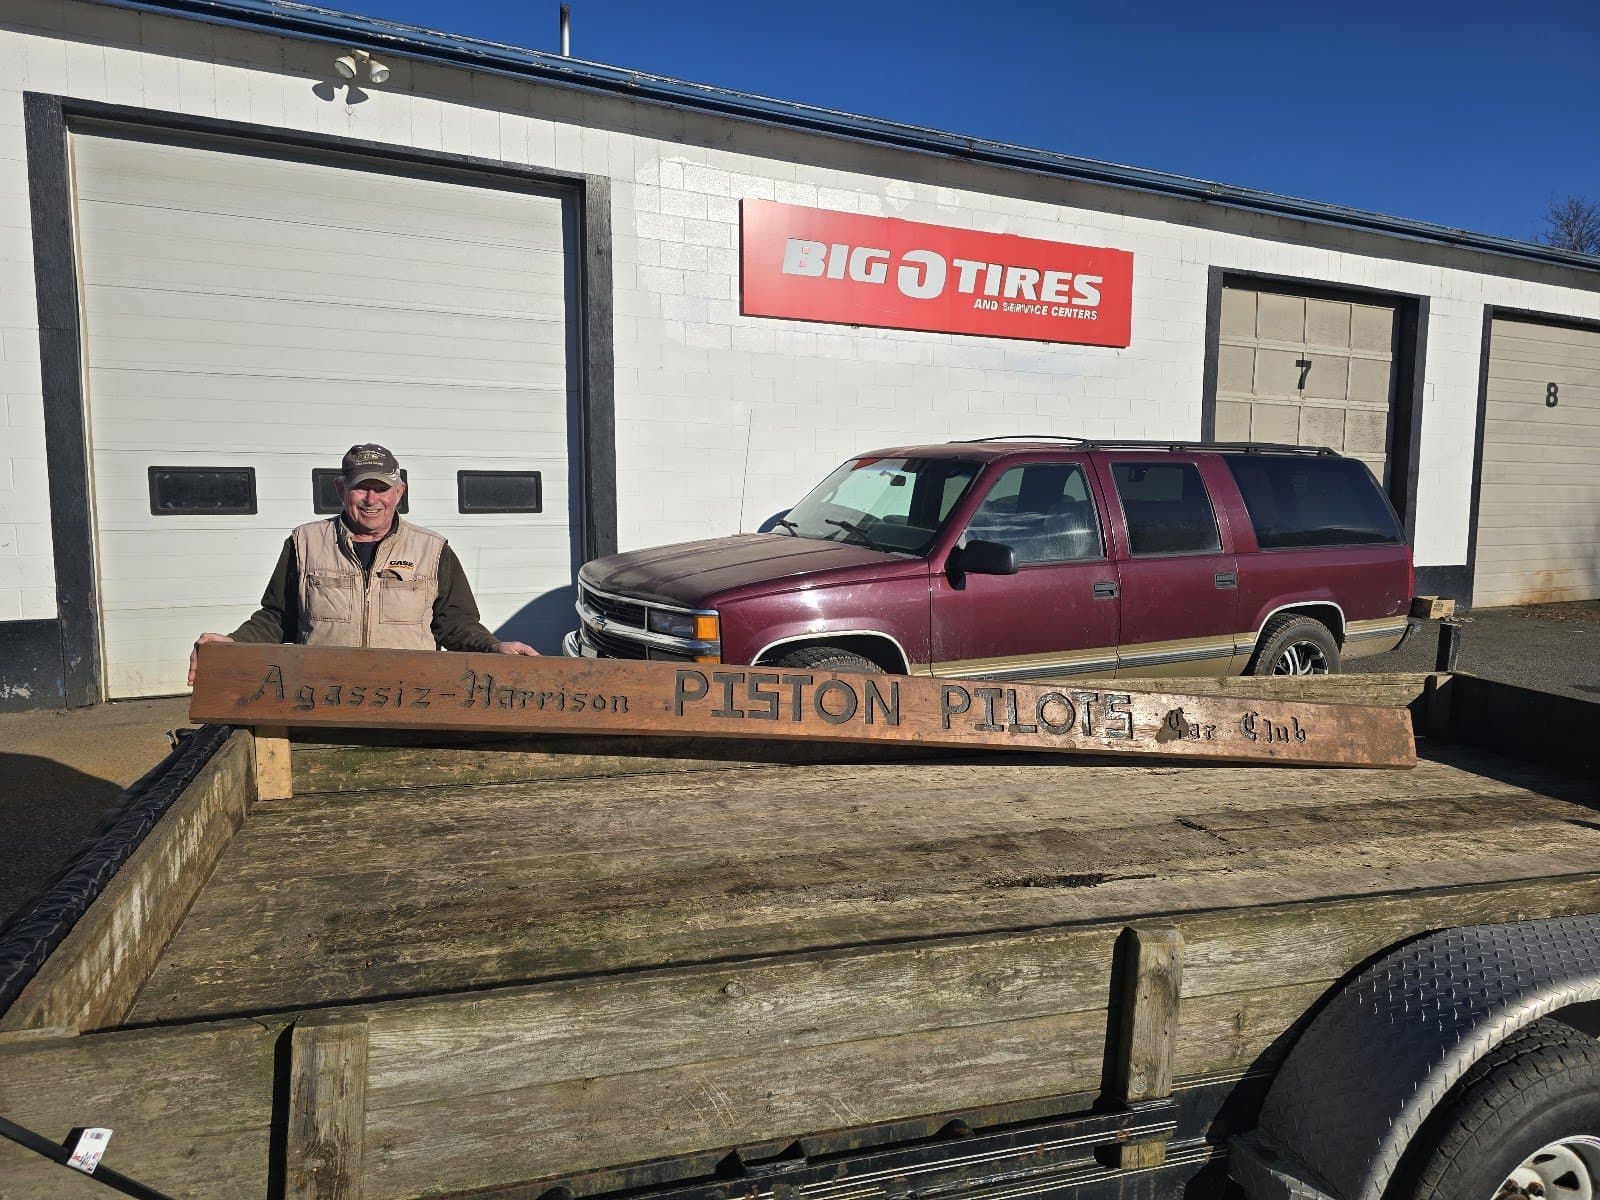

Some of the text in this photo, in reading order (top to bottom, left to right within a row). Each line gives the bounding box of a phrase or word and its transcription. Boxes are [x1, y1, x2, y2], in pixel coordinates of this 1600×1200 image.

[782, 237, 1104, 307] BIG O TIRES
[973, 298, 1098, 320] AND SERVICE CENTERS
[1295, 359, 1312, 389] 7
[1545, 382, 1559, 407] 8
[248, 664, 1307, 744] Agassiz-Harrison PISTON PILOTS Car Club
